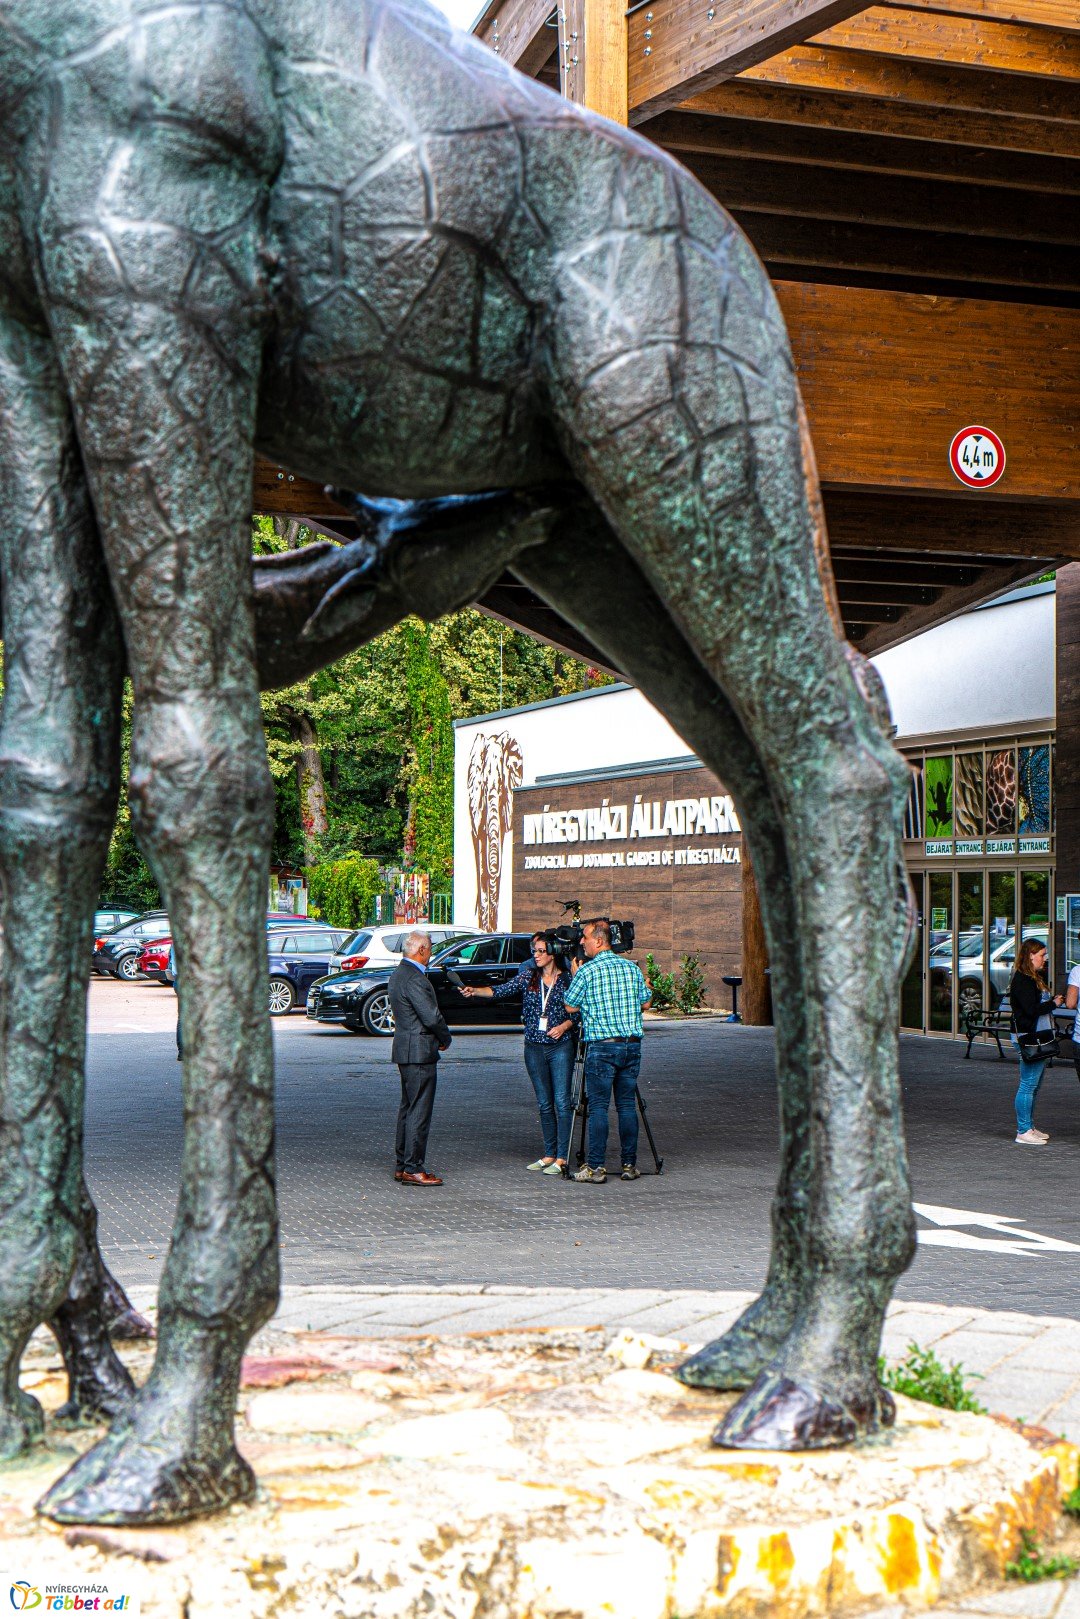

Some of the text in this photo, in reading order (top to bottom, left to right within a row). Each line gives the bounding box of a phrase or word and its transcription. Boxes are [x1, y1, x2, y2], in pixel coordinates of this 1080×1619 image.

[523, 794, 742, 845] NYÍREGYHÁZI ÁLLATPARK
[524, 844, 742, 870] ZOOLOGICAL AND BOTANICAL GARDEN OF NYÍREGYHÁZA
[926, 841, 1050, 854] BEJÁRAT ENTRANCE BEJÁRAT ENTRANCE
